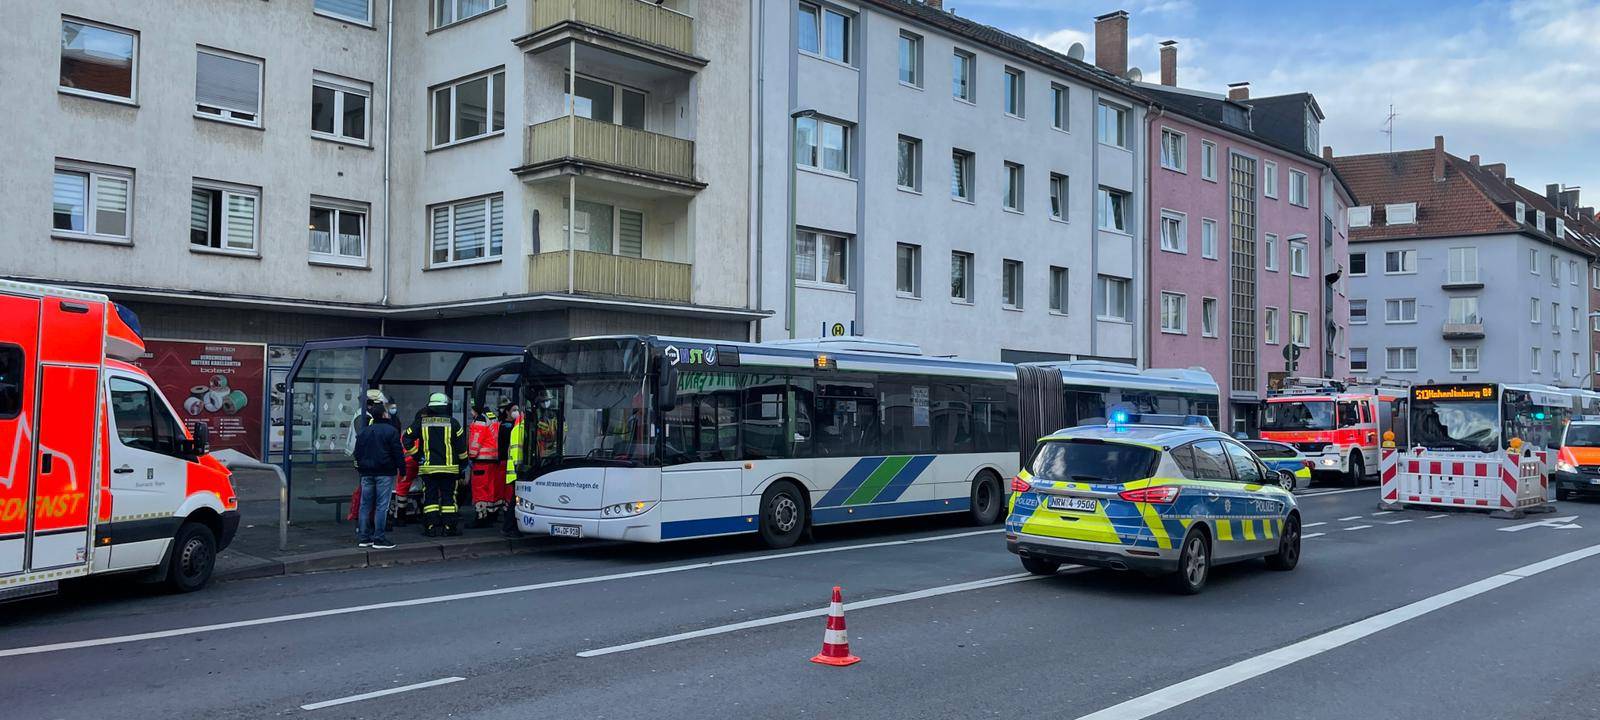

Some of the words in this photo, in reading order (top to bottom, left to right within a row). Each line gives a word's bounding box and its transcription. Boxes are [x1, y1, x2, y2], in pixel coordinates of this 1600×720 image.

[1015, 496, 1038, 507] POLIZEI
[1052, 498, 1065, 507] NRW
[1076, 501, 1095, 510] 9506
[1256, 500, 1275, 512] POLIZEI
